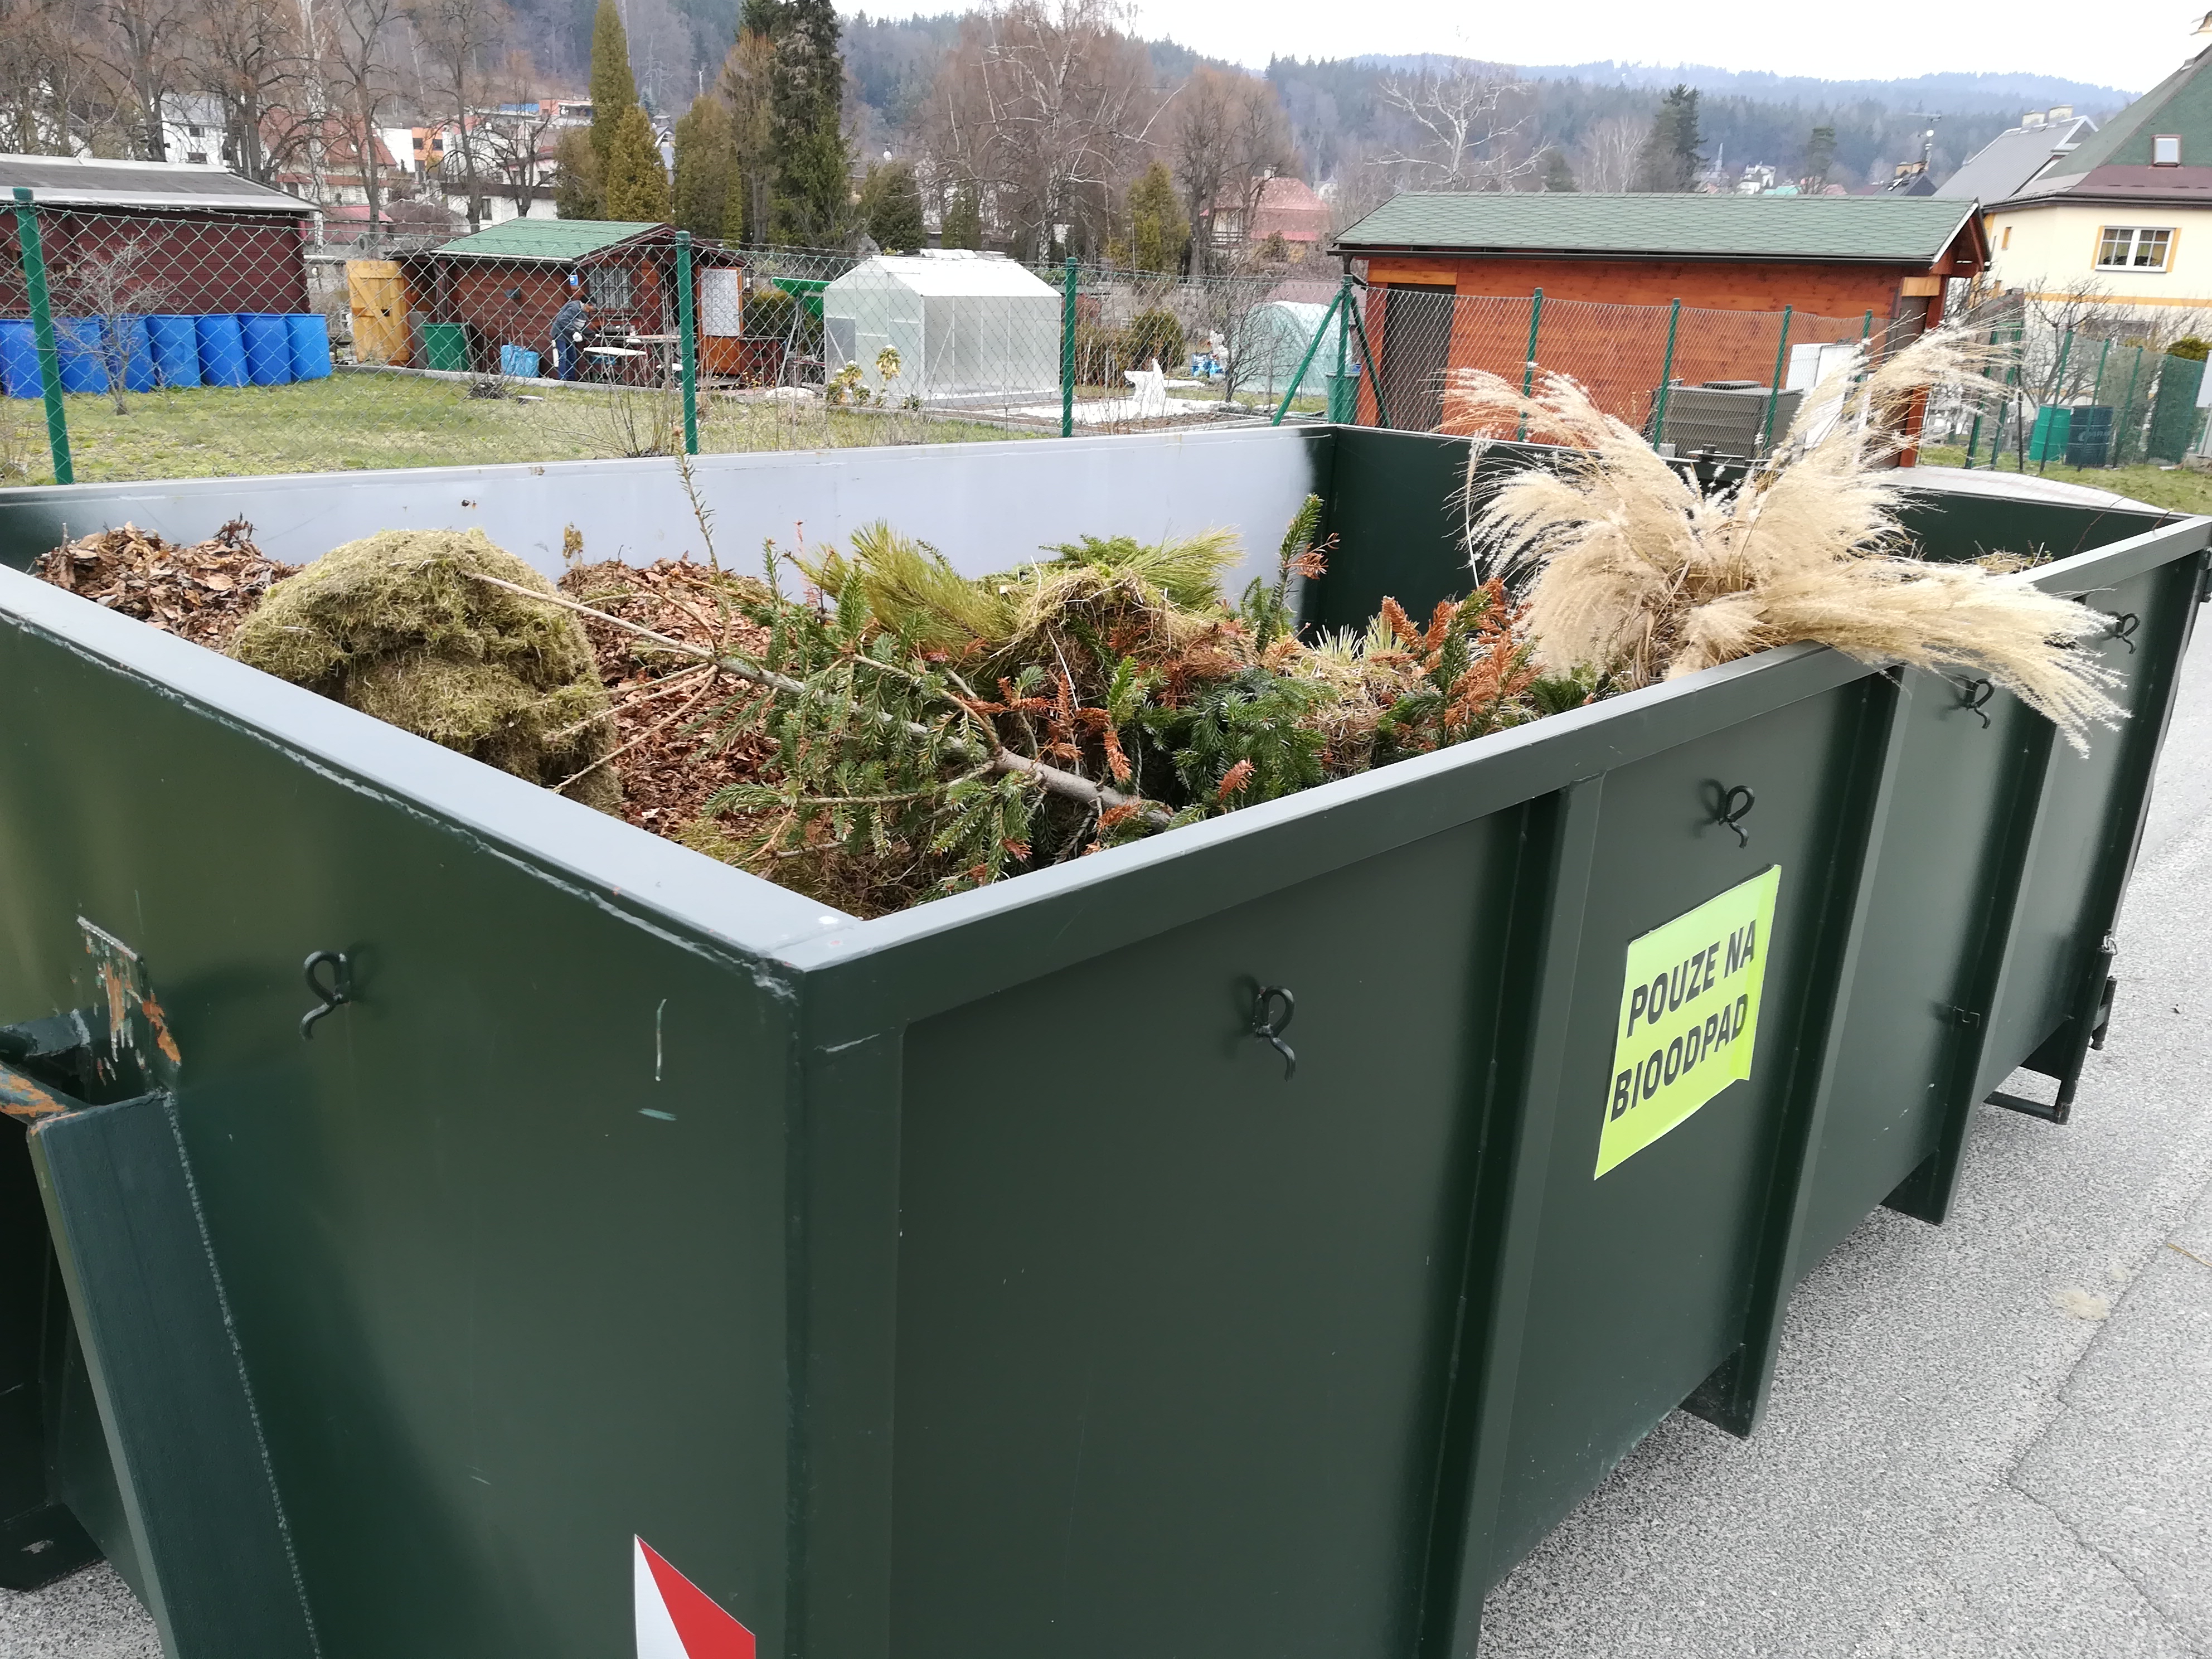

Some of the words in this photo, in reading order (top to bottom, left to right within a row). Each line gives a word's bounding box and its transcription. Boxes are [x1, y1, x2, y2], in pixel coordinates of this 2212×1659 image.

[1627, 941, 1720, 1038] POUZE
[1724, 919, 1756, 979] NA
[1610, 993, 1748, 1123] BIOODPAD
